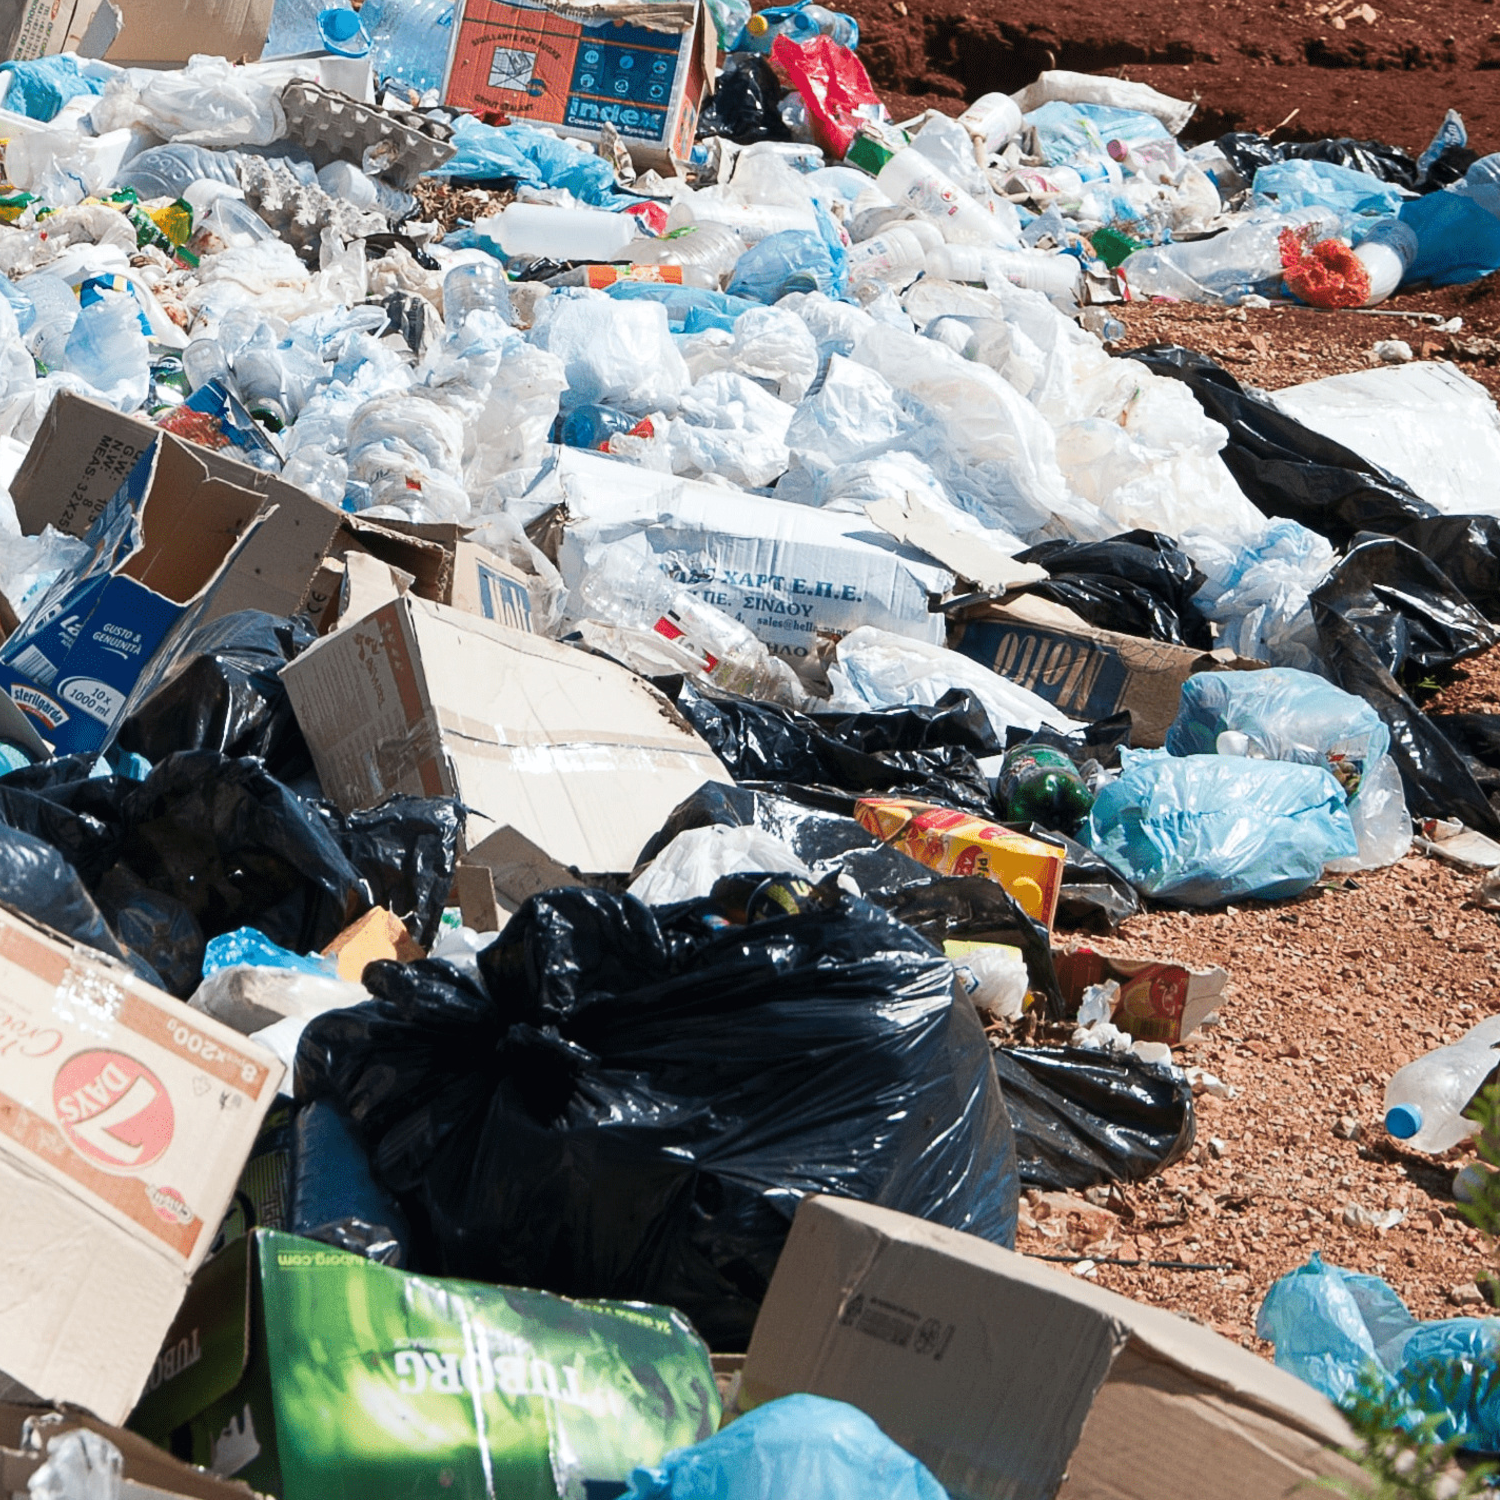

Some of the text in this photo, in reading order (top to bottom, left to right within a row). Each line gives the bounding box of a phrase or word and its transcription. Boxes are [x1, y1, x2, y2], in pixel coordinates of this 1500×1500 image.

[474, 94, 498, 111] GROUT
[568, 96, 661, 130] index
[100, 439, 124, 473] N.W.:
[57, 434, 113, 530] MEAS: 32X25
[743, 596, 814, 618] ΣΙΝΔΟΥ
[92, 631, 143, 656] GENUINITÀ
[102, 622, 143, 643] GUSTO &
[13, 687, 63, 724] sterilgarda
[69, 688, 112, 718] 1000 ml
[90, 688, 105, 701] 10
[58, 1062, 132, 1123] DAYS
[71, 1074, 158, 1166] 7
[143, 1328, 201, 1391] TUBO
[395, 1351, 591, 1407] TUBORG
